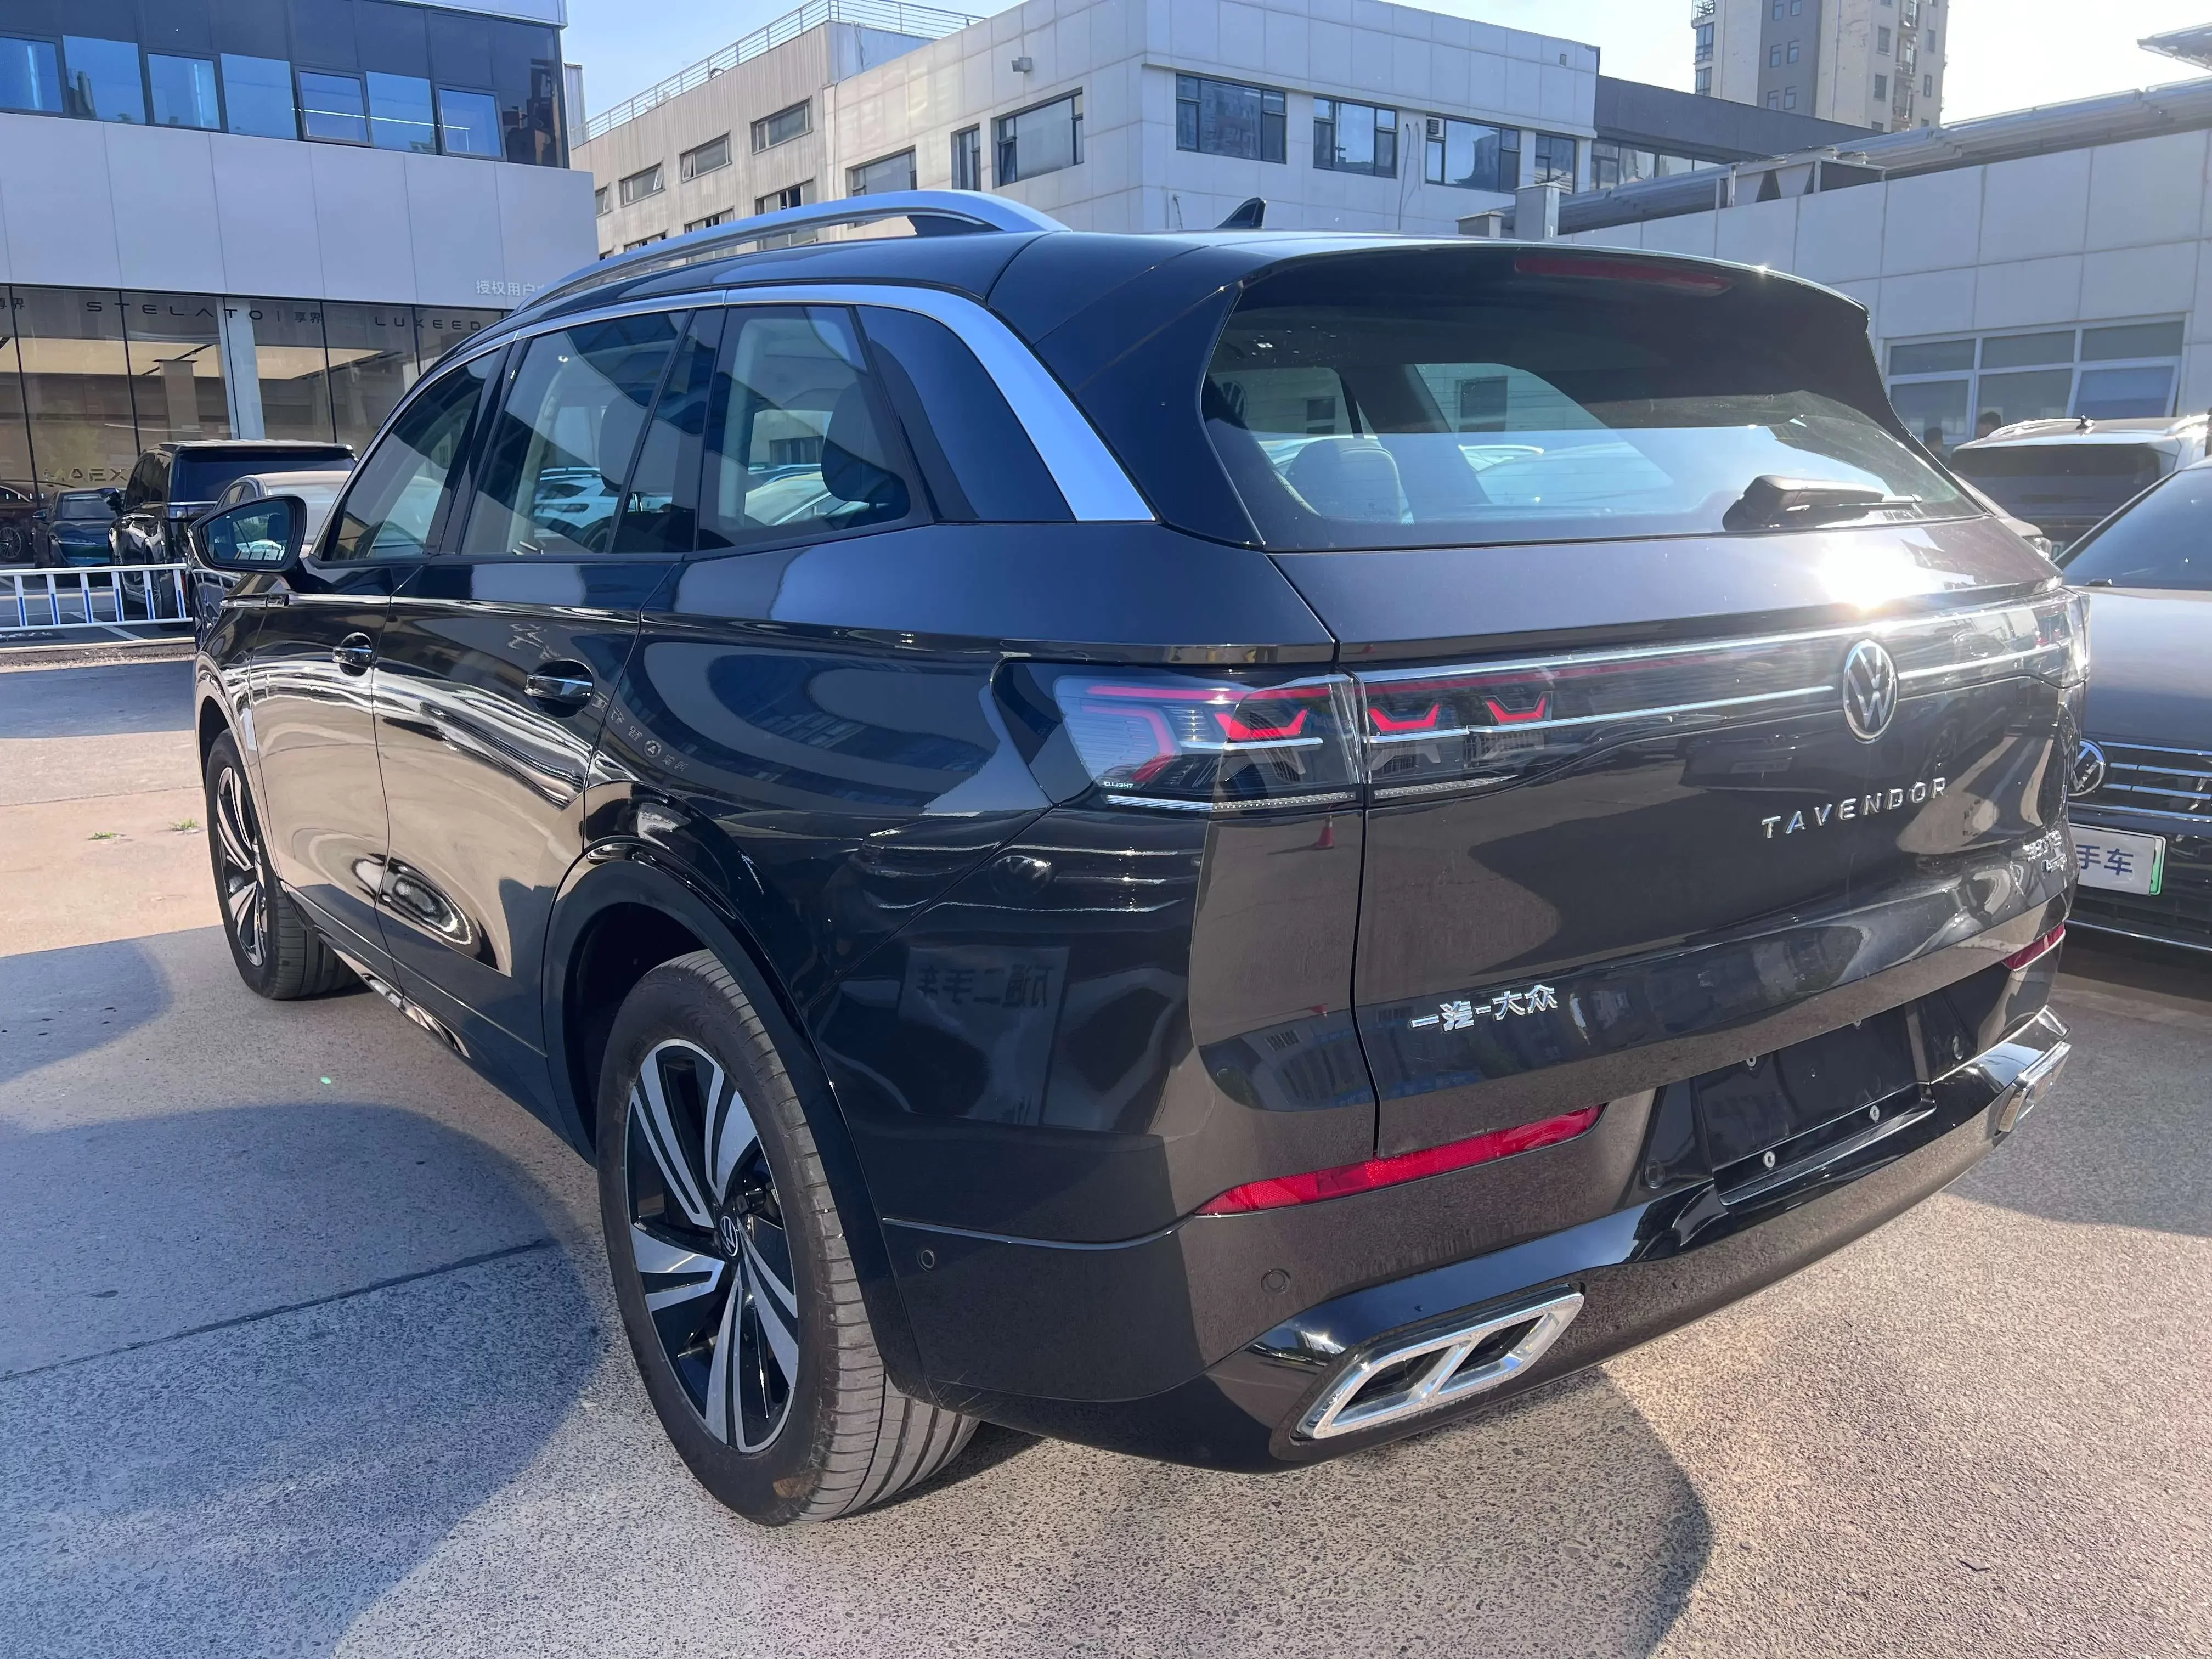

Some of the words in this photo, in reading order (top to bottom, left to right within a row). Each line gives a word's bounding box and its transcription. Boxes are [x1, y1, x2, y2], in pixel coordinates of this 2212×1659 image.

[476, 279, 544, 296] 授权用户
[86, 301, 263, 320] STELATO
[375, 316, 481, 330] LUXEED
[1760, 777, 1947, 839] TAVENDOR
[1409, 984, 1558, 1031] 一汽-大众
